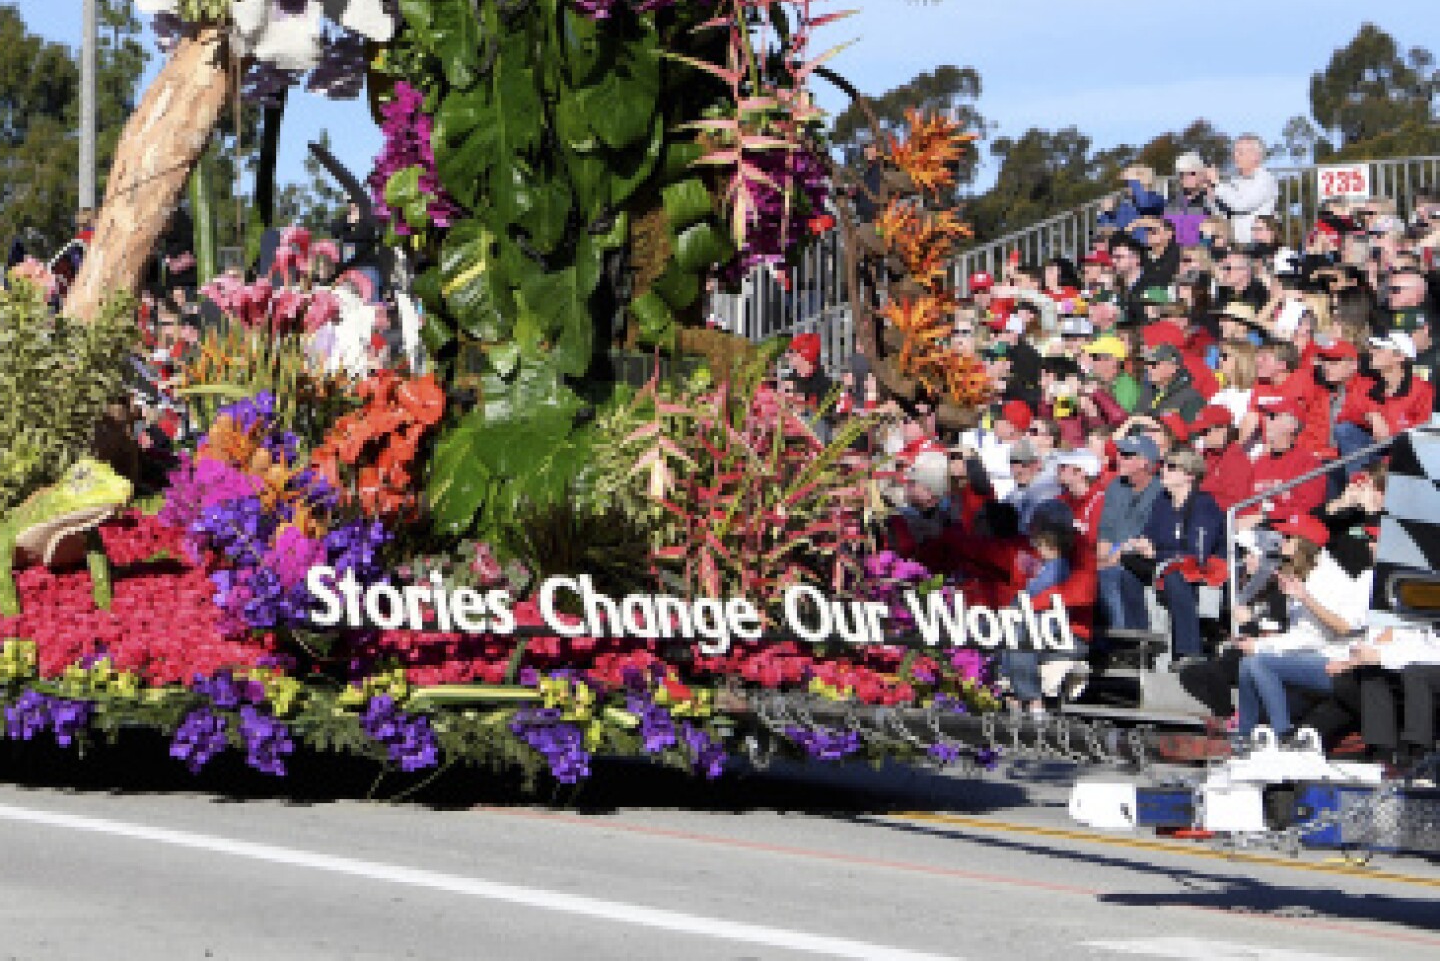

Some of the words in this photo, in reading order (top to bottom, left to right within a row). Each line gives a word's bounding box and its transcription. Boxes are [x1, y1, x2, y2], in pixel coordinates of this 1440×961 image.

[1321, 170, 1366, 195] 235
[306, 565, 515, 634] Stories
[539, 573, 762, 654] Change
[784, 583, 889, 643] Our
[902, 589, 1074, 651] World
